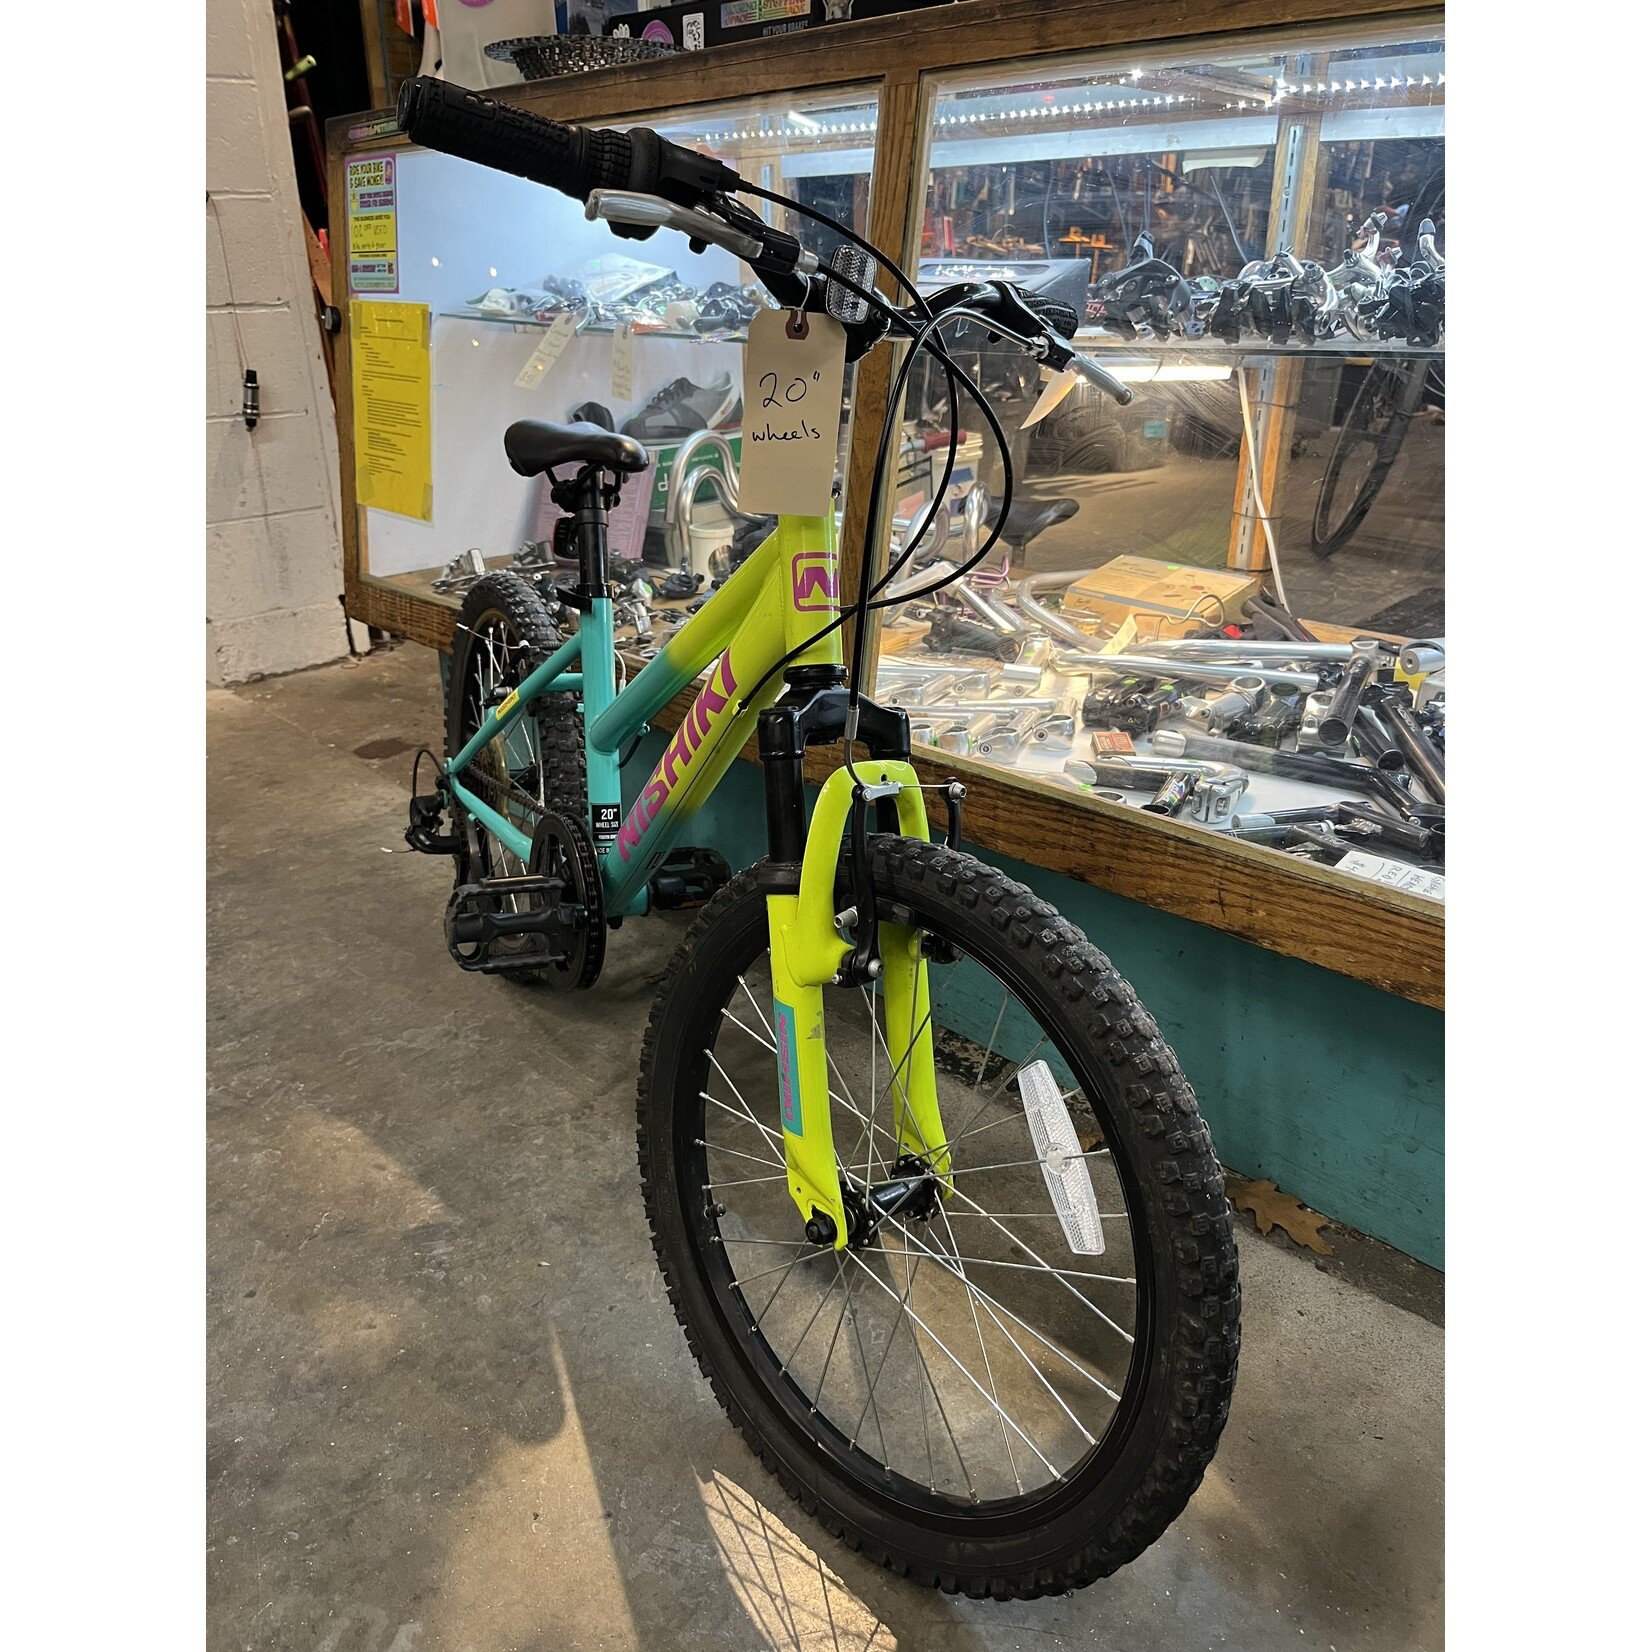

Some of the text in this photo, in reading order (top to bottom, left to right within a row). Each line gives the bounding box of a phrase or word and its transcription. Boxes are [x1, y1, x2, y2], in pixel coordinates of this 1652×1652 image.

[360, 163, 372, 175] YOUR
[372, 161, 384, 173] BIKE
[354, 176, 366, 188] SAVE
[759, 371, 820, 408] 20"
[752, 420, 821, 442] wheels
[618, 647, 738, 862] NISHIKI
[600, 808, 618, 820] 20"
